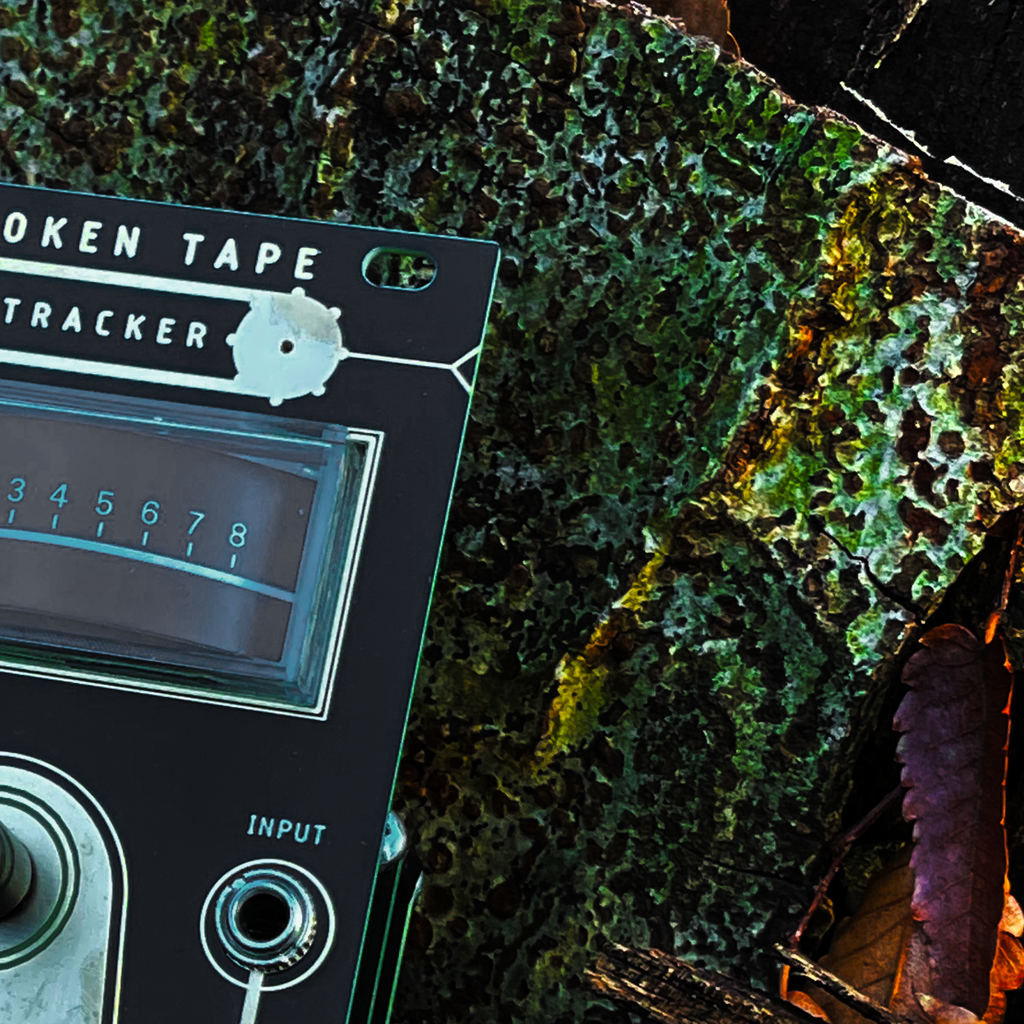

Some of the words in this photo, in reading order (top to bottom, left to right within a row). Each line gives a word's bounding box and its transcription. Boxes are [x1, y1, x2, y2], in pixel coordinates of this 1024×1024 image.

[182, 233, 322, 281] TAPE
[2, 297, 209, 349] TRACKER
[7, 477, 26, 502] 3
[49, 483, 69, 509] 4
[95, 490, 115, 516] 5
[141, 500, 160, 525] 6
[187, 510, 206, 535] 7
[228, 522, 248, 548] 8
[246, 814, 327, 846] INPUT
